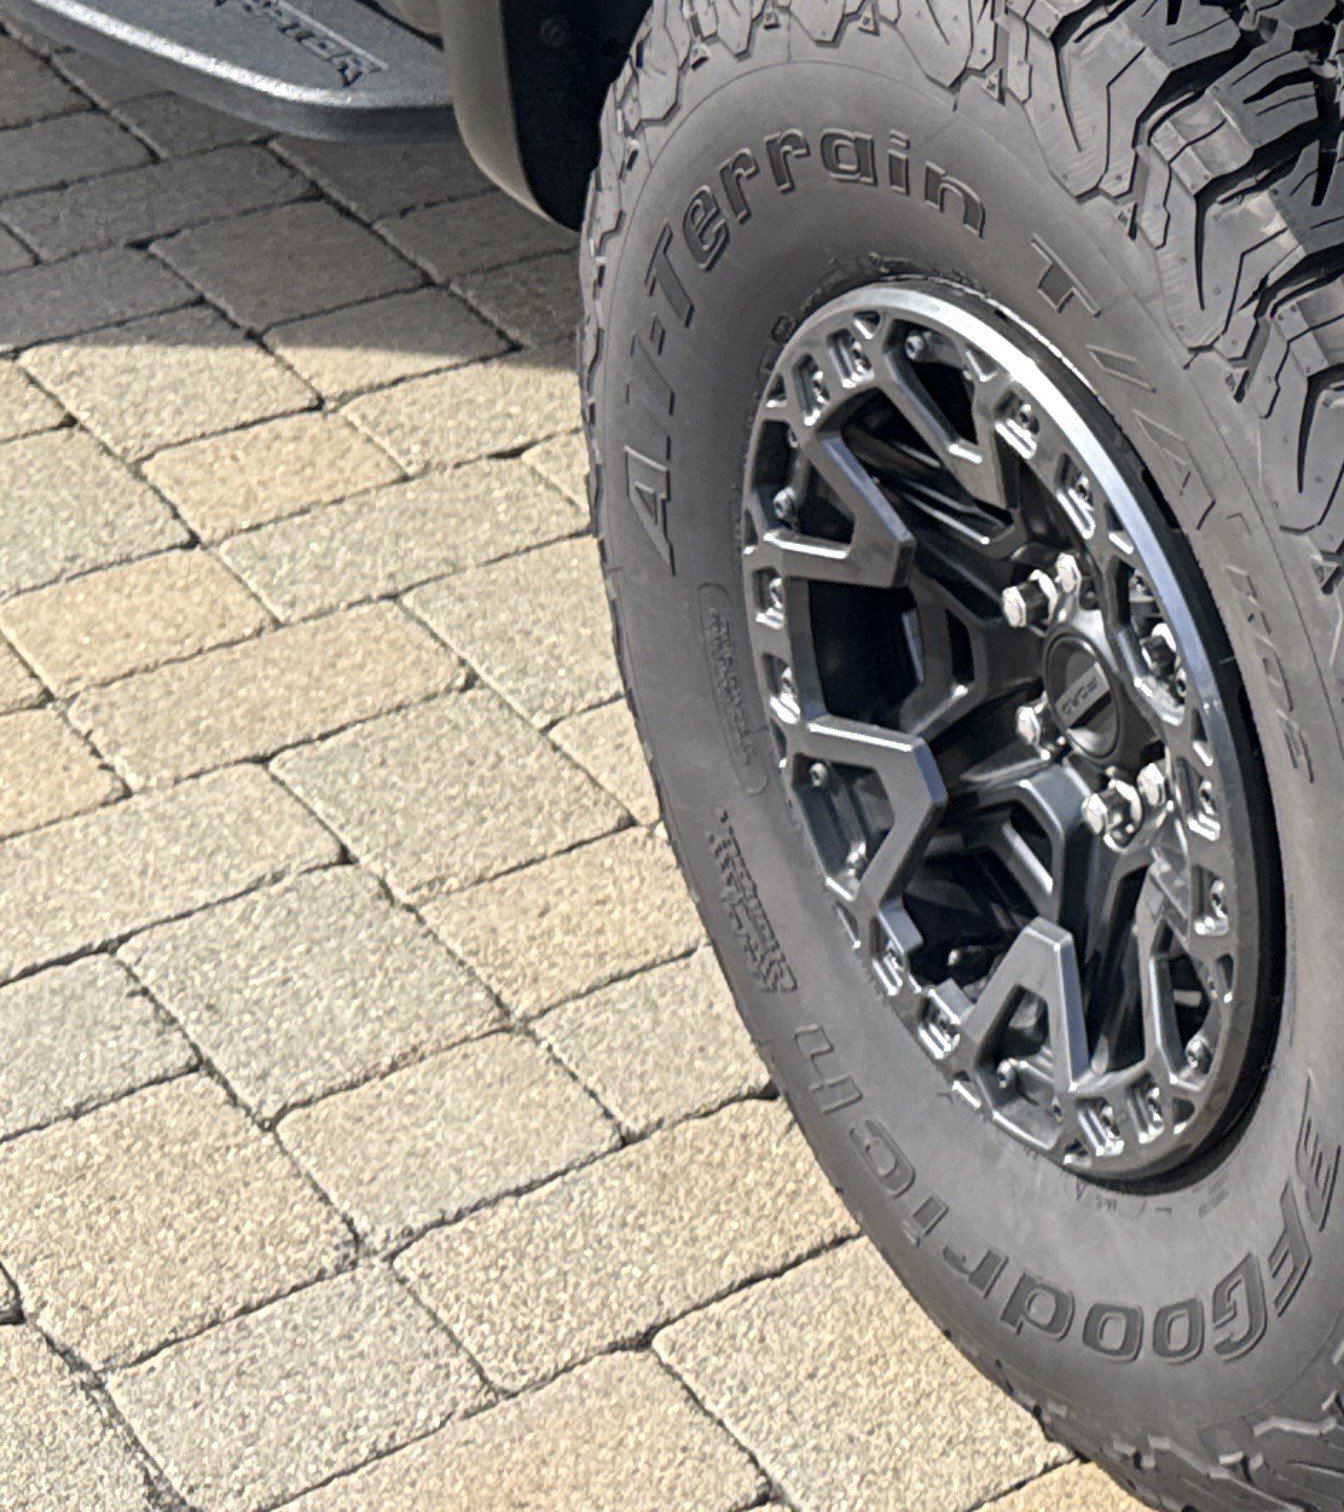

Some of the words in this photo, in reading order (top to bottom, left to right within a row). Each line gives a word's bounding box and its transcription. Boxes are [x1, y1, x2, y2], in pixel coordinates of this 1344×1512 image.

[623, 126, 987, 577] All-Terrain
[1030, 232, 1217, 531] T/A
[793, 1023, 1342, 1365] BFGoodrich
